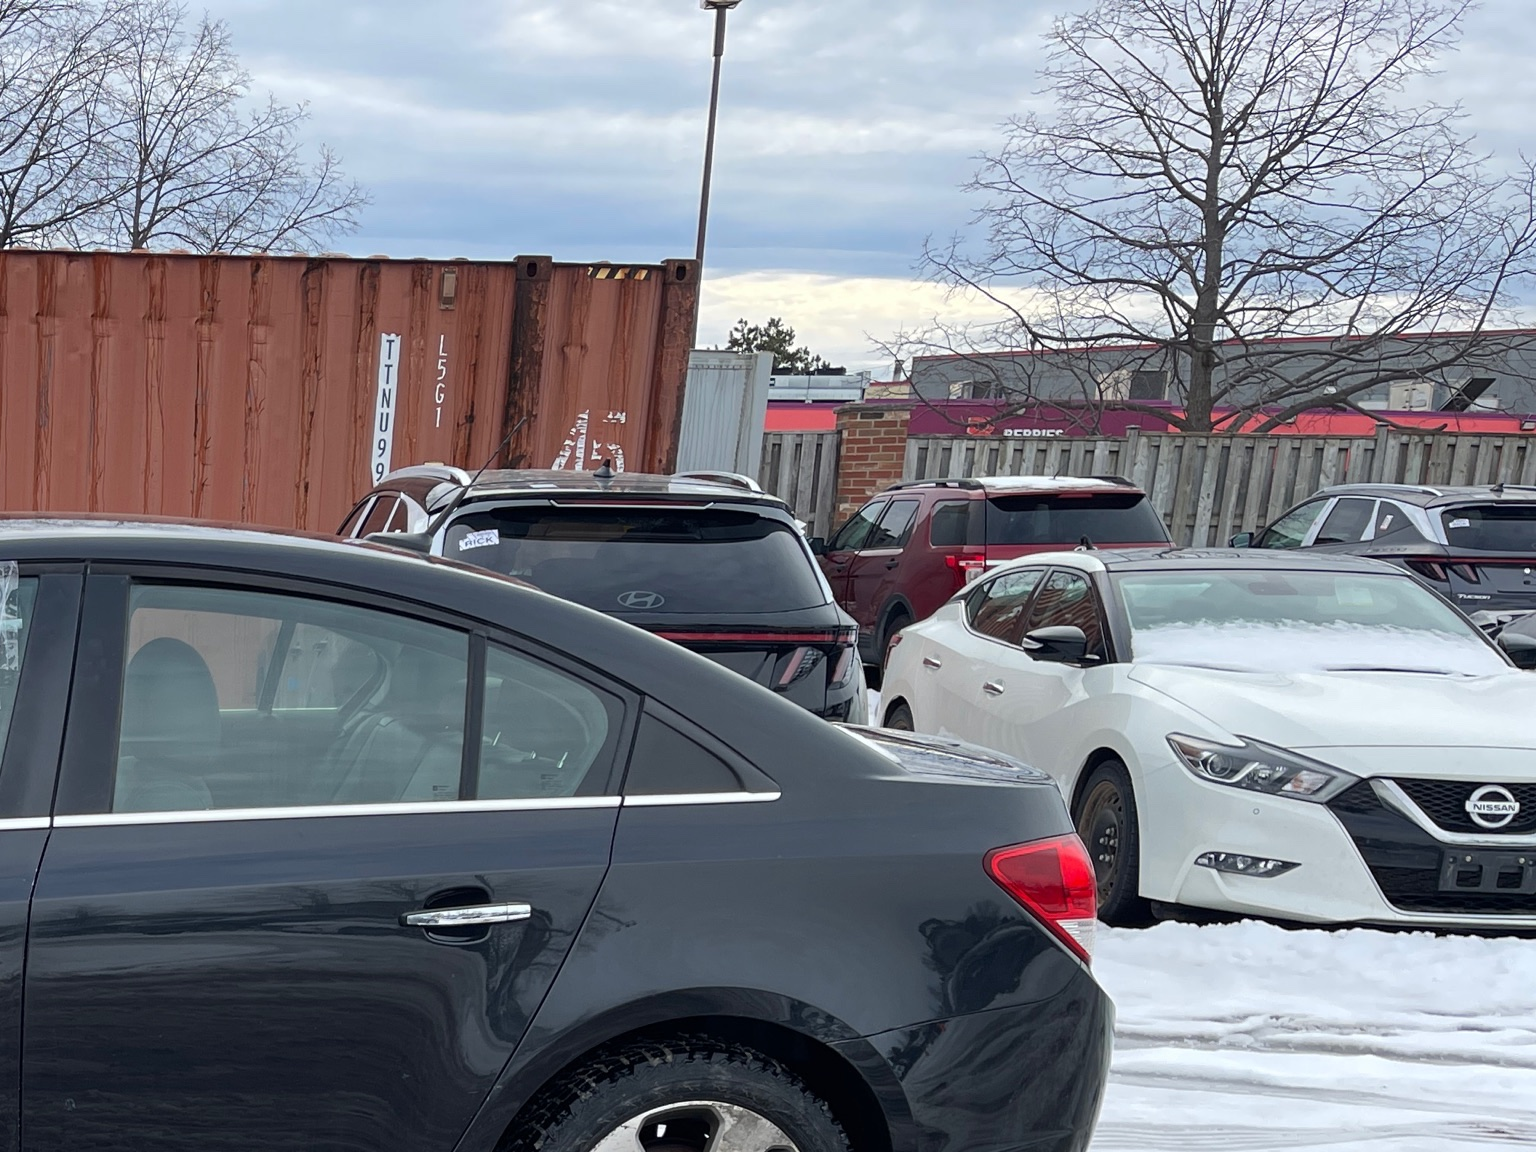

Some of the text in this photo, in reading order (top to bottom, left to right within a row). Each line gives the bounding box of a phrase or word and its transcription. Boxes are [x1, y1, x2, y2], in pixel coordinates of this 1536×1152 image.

[375, 339, 395, 482] TTNU99
[435, 334, 448, 428] L5G1
[1473, 803, 1516, 812] NISSAN
